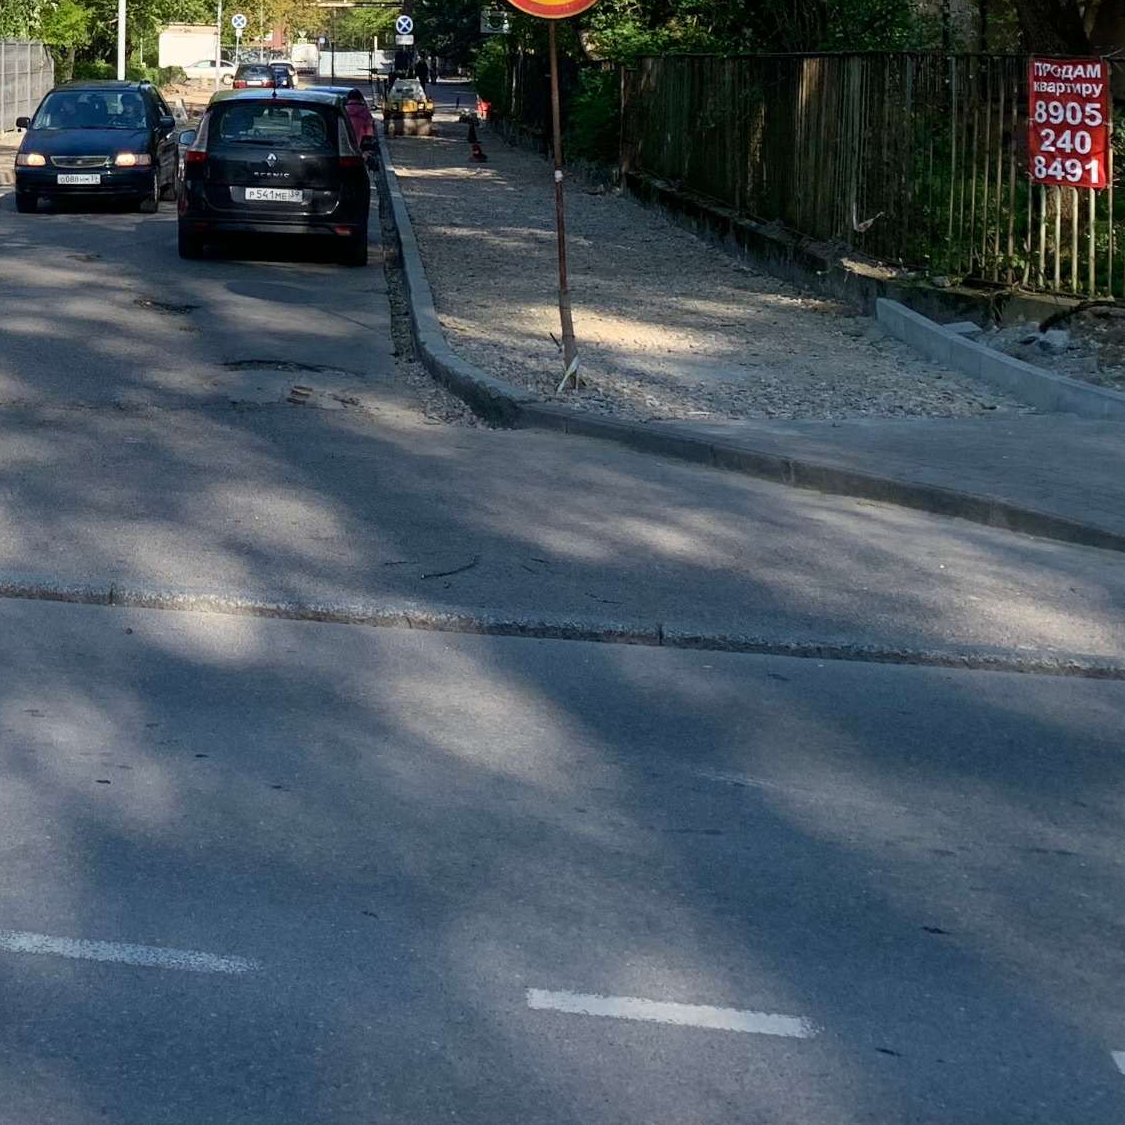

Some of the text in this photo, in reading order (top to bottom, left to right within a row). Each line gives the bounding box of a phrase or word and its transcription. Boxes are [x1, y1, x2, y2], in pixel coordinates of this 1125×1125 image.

[1034, 62, 1101, 80] ПРОДАМ
[1033, 81, 1103, 98] квартиру
[1034, 100, 1103, 126] 8905
[1040, 128, 1092, 154] 240
[1034, 155, 1099, 184] 8491
